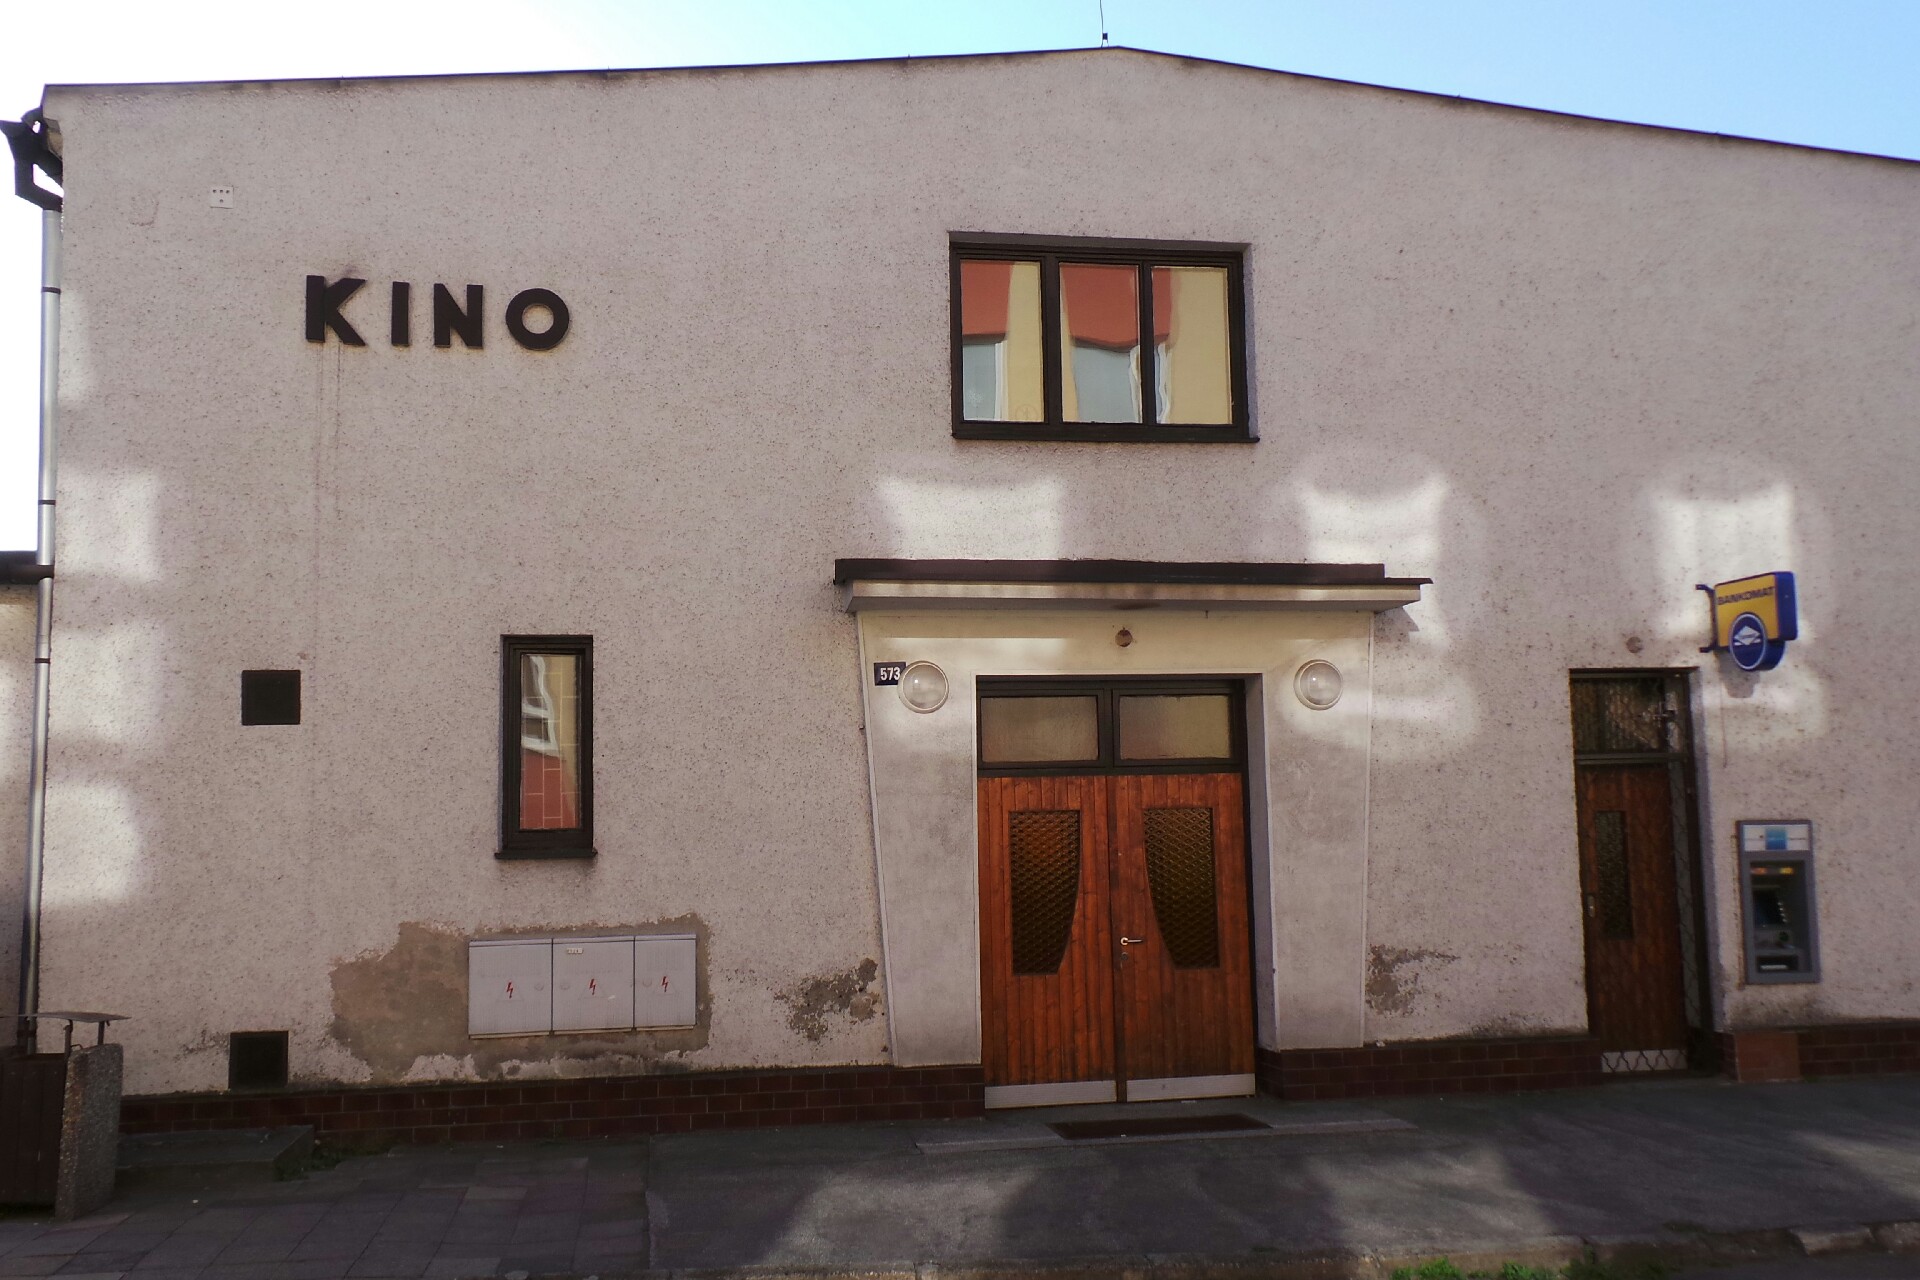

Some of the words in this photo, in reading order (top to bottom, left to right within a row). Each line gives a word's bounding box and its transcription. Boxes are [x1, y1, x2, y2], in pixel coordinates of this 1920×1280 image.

[306, 275, 570, 350] KINO
[1718, 586, 1775, 605] BANKOMAT
[880, 667, 900, 680] 573
